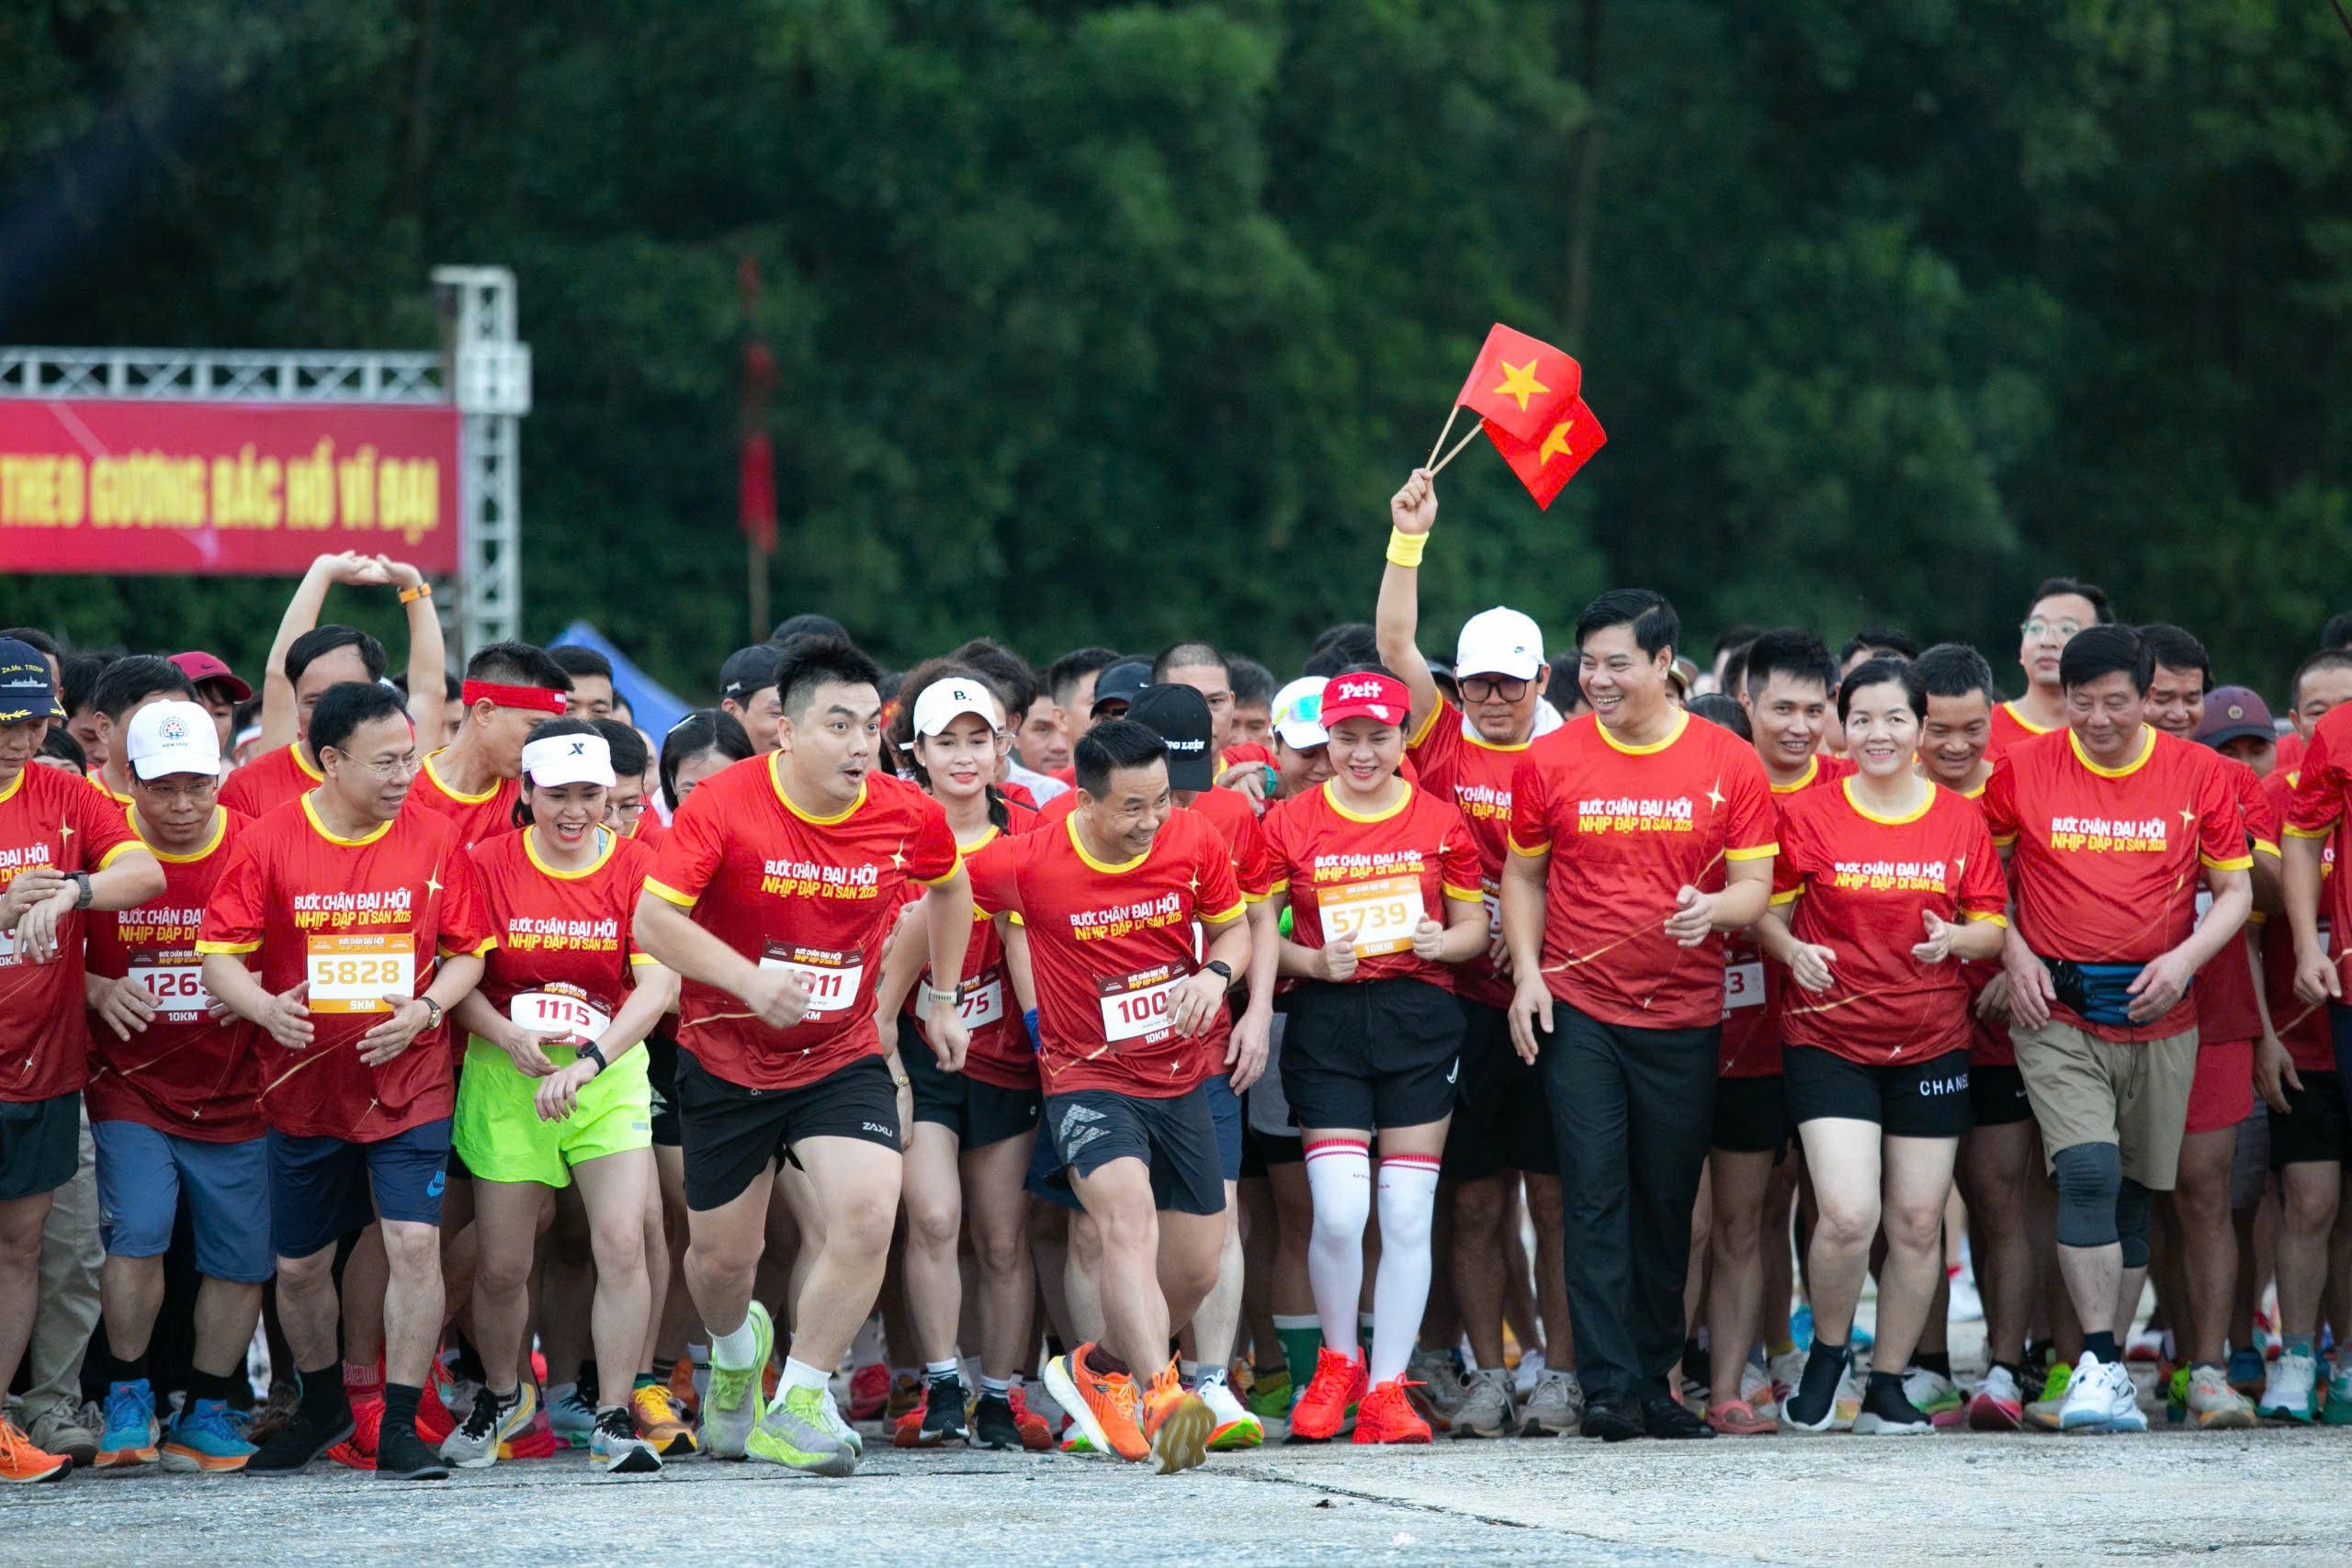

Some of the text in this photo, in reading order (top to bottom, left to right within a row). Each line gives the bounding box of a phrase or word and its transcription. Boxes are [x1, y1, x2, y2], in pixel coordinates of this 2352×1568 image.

[0, 455, 84, 528] THEO
[211, 442, 282, 529] BÁC
[1496, 792, 1511, 808] ĐẠ
[1332, 902, 1407, 934] 5739
[143, 973, 207, 997] 126
[317, 960, 400, 985] 5828
[792, 970, 842, 998] 011
[168, 1011, 198, 1022] 10KM
[537, 999, 590, 1026] 1115
[1118, 988, 1172, 1024] 100
[1145, 1029, 1170, 1044] 10KM
[862, 1122, 893, 1137] ZAXU
